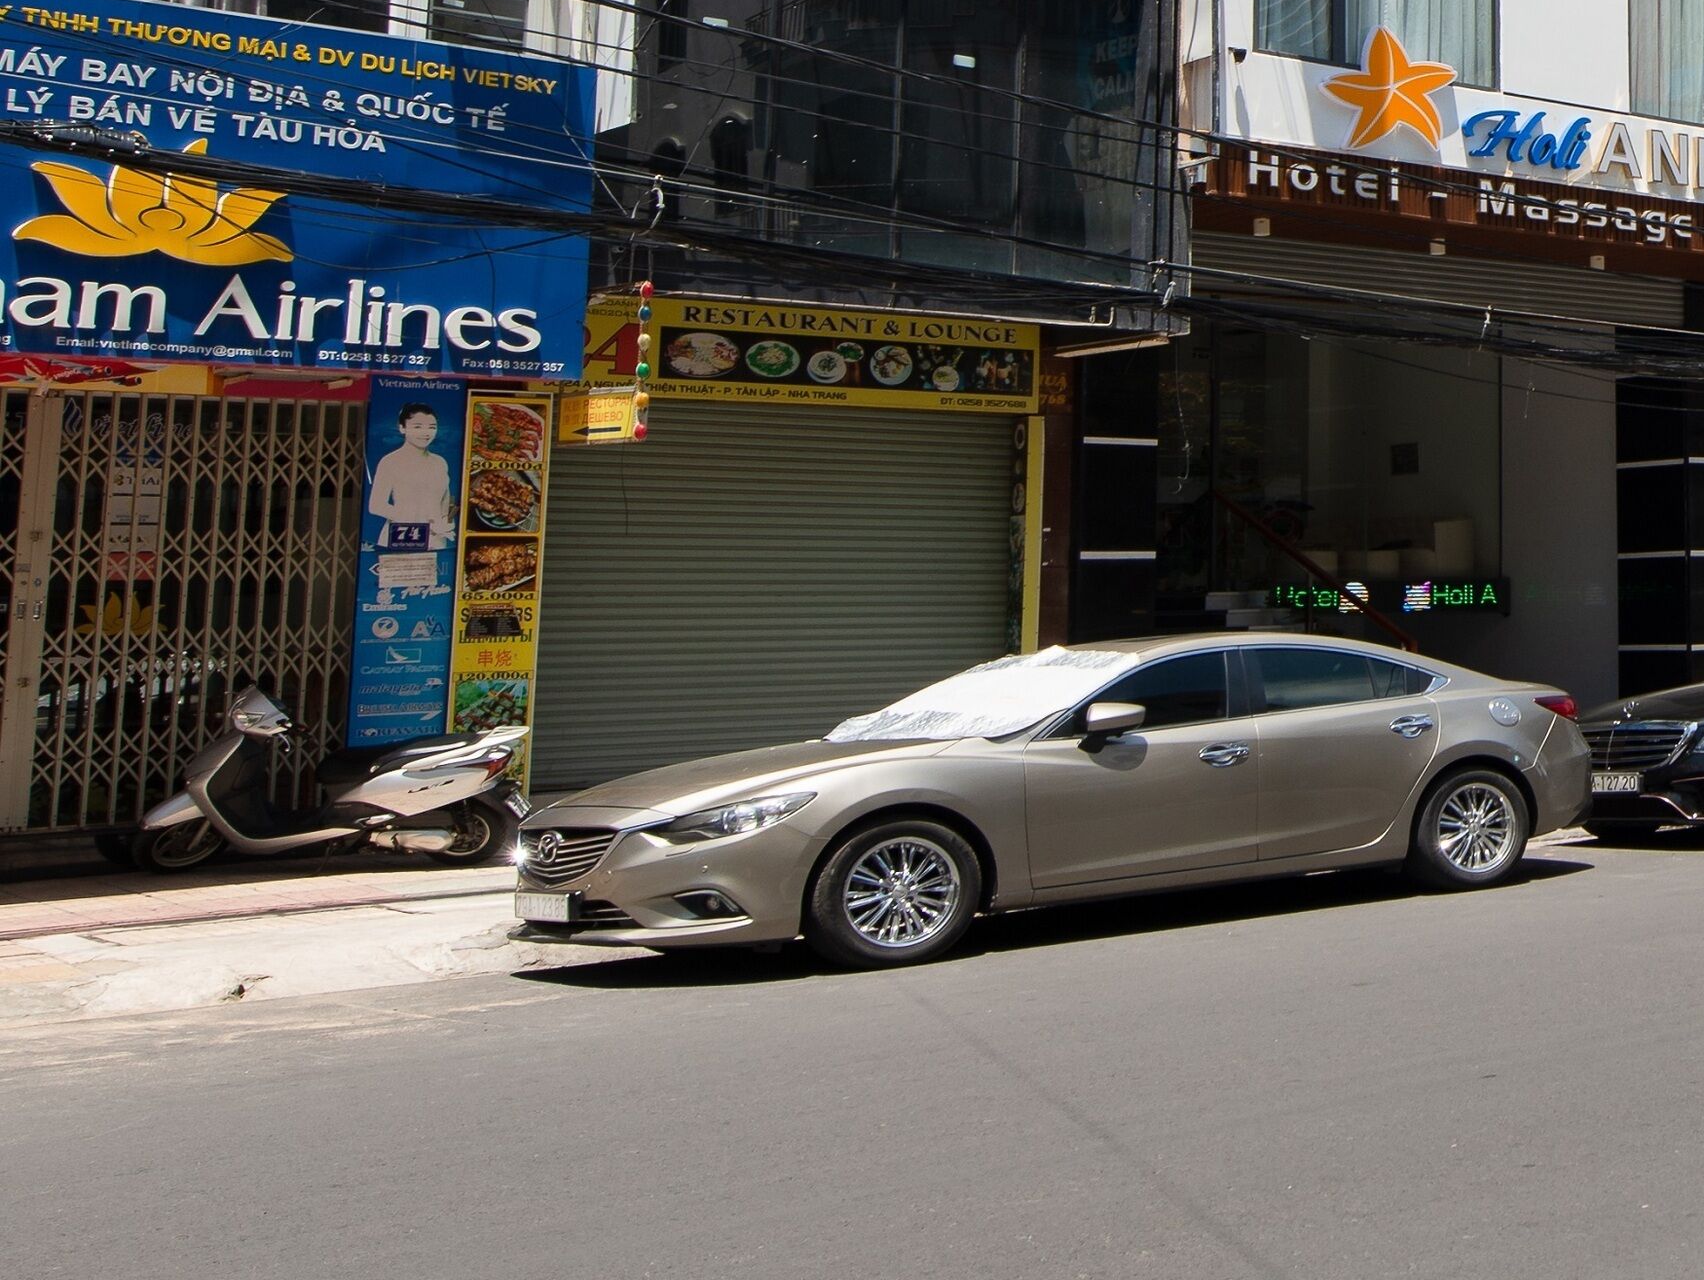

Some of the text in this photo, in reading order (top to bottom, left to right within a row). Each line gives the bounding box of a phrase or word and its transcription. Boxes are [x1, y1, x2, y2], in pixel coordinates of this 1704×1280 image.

[22, 6, 100, 34] TNHH
[108, 17, 231, 51] THƯƠNG
[238, 36, 287, 61] MẠI
[292, 43, 312, 62] &
[318, 46, 355, 68] DV
[361, 53, 396, 74] DU
[401, 58, 456, 82] LỊCH
[6, 86, 55, 115] LÝ
[69, 94, 152, 128] BÁN
[231, 111, 303, 143] TÀU
[81, 58, 157, 89] BAY
[321, 90, 346, 113] &
[355, 92, 455, 125] QUỐC
[464, 102, 511, 132] TẾ
[1461, 109, 1593, 171] Holi
[1248, 149, 1399, 202] Hotel
[1478, 178, 1693, 244] Massage
[193, 273, 542, 353] Airlines
[682, 305, 1018, 344] RESTAURANT & LOUNGE
[375, 353, 406, 365] 3527
[408, 354, 433, 366] 327
[513, 360, 540, 372] 3527
[542, 362, 565, 373] 357
[378, 378, 461, 391] Vietnam Airlines
[679, 383, 716, 396] THUẬT
[736, 385, 757, 396] TÂN
[759, 387, 780, 399] LẬP
[788, 389, 810, 400] NHA
[812, 391, 848, 401] TRANG
[957, 398, 983, 408] 0258
[581, 410, 624, 424] ДЕШЕВО
[396, 526, 421, 541] 74
